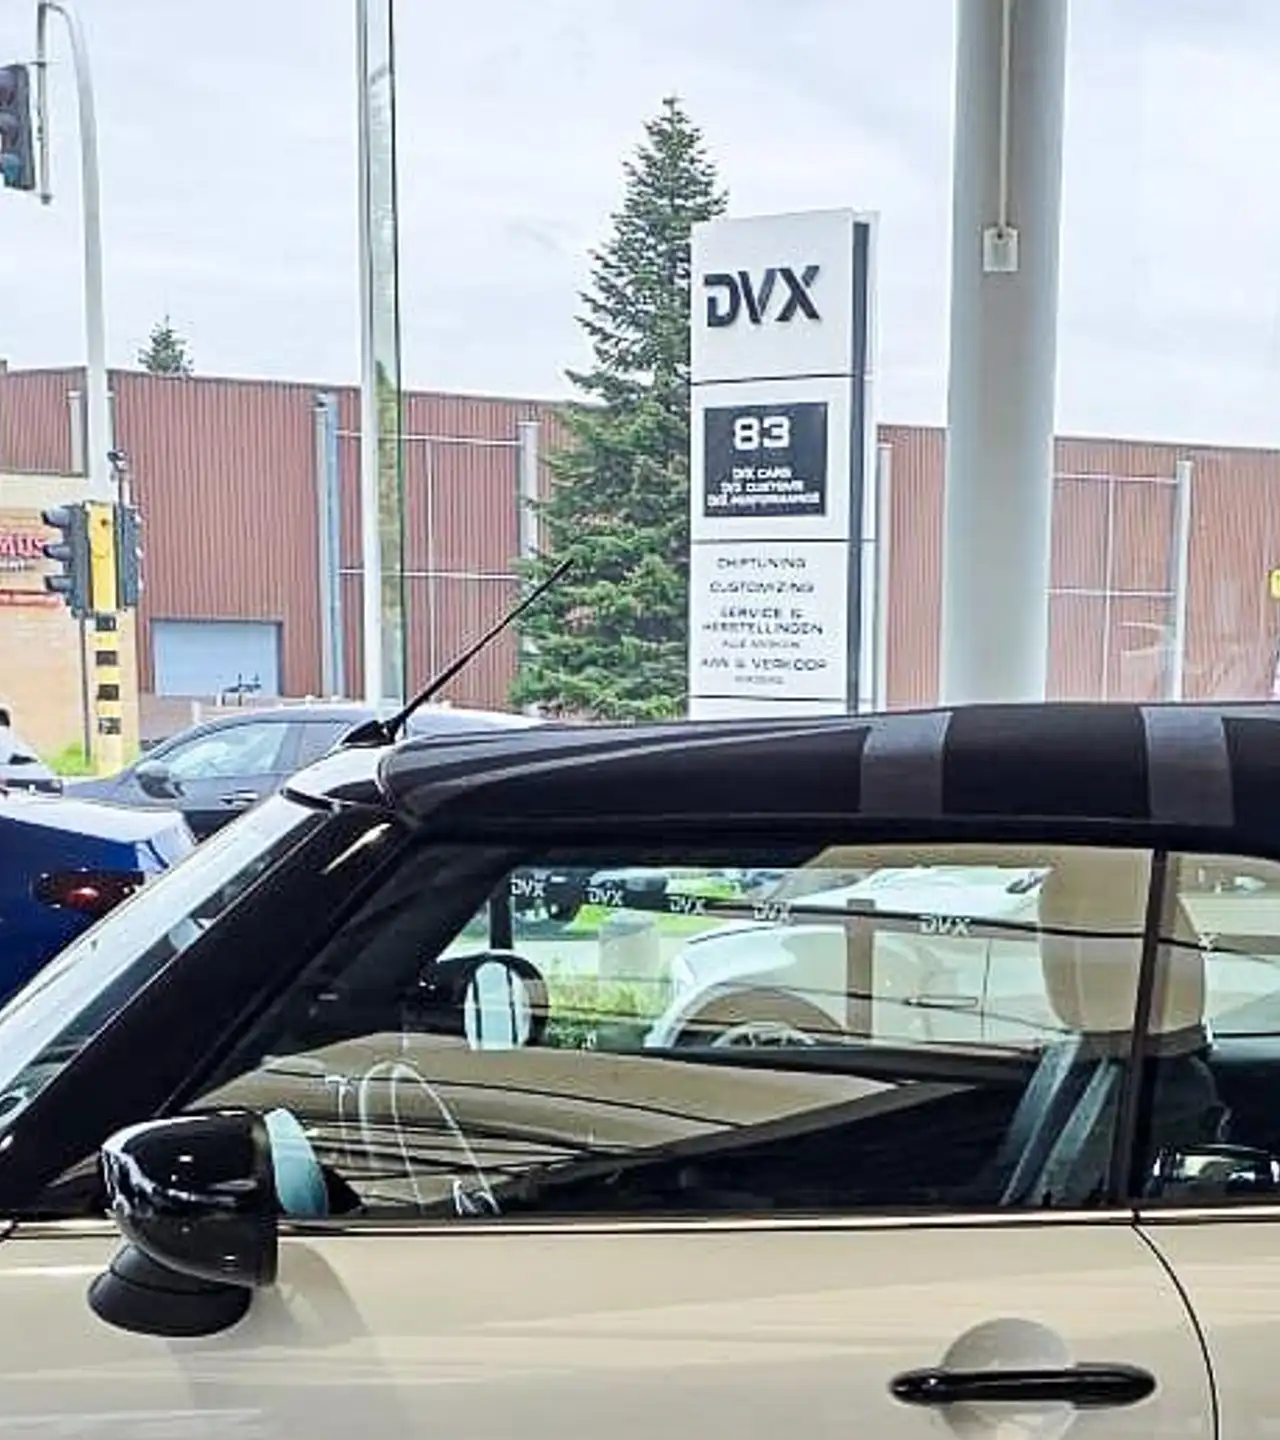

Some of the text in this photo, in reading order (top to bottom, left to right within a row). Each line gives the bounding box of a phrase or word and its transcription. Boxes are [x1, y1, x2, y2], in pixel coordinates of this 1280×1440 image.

[704, 265, 821, 327] DVX
[733, 416, 790, 451] 83
[511, 878, 545, 898] DVX
[587, 887, 623, 906] DVX
[669, 895, 706, 915] DVX
[920, 913, 970, 935] DVX
